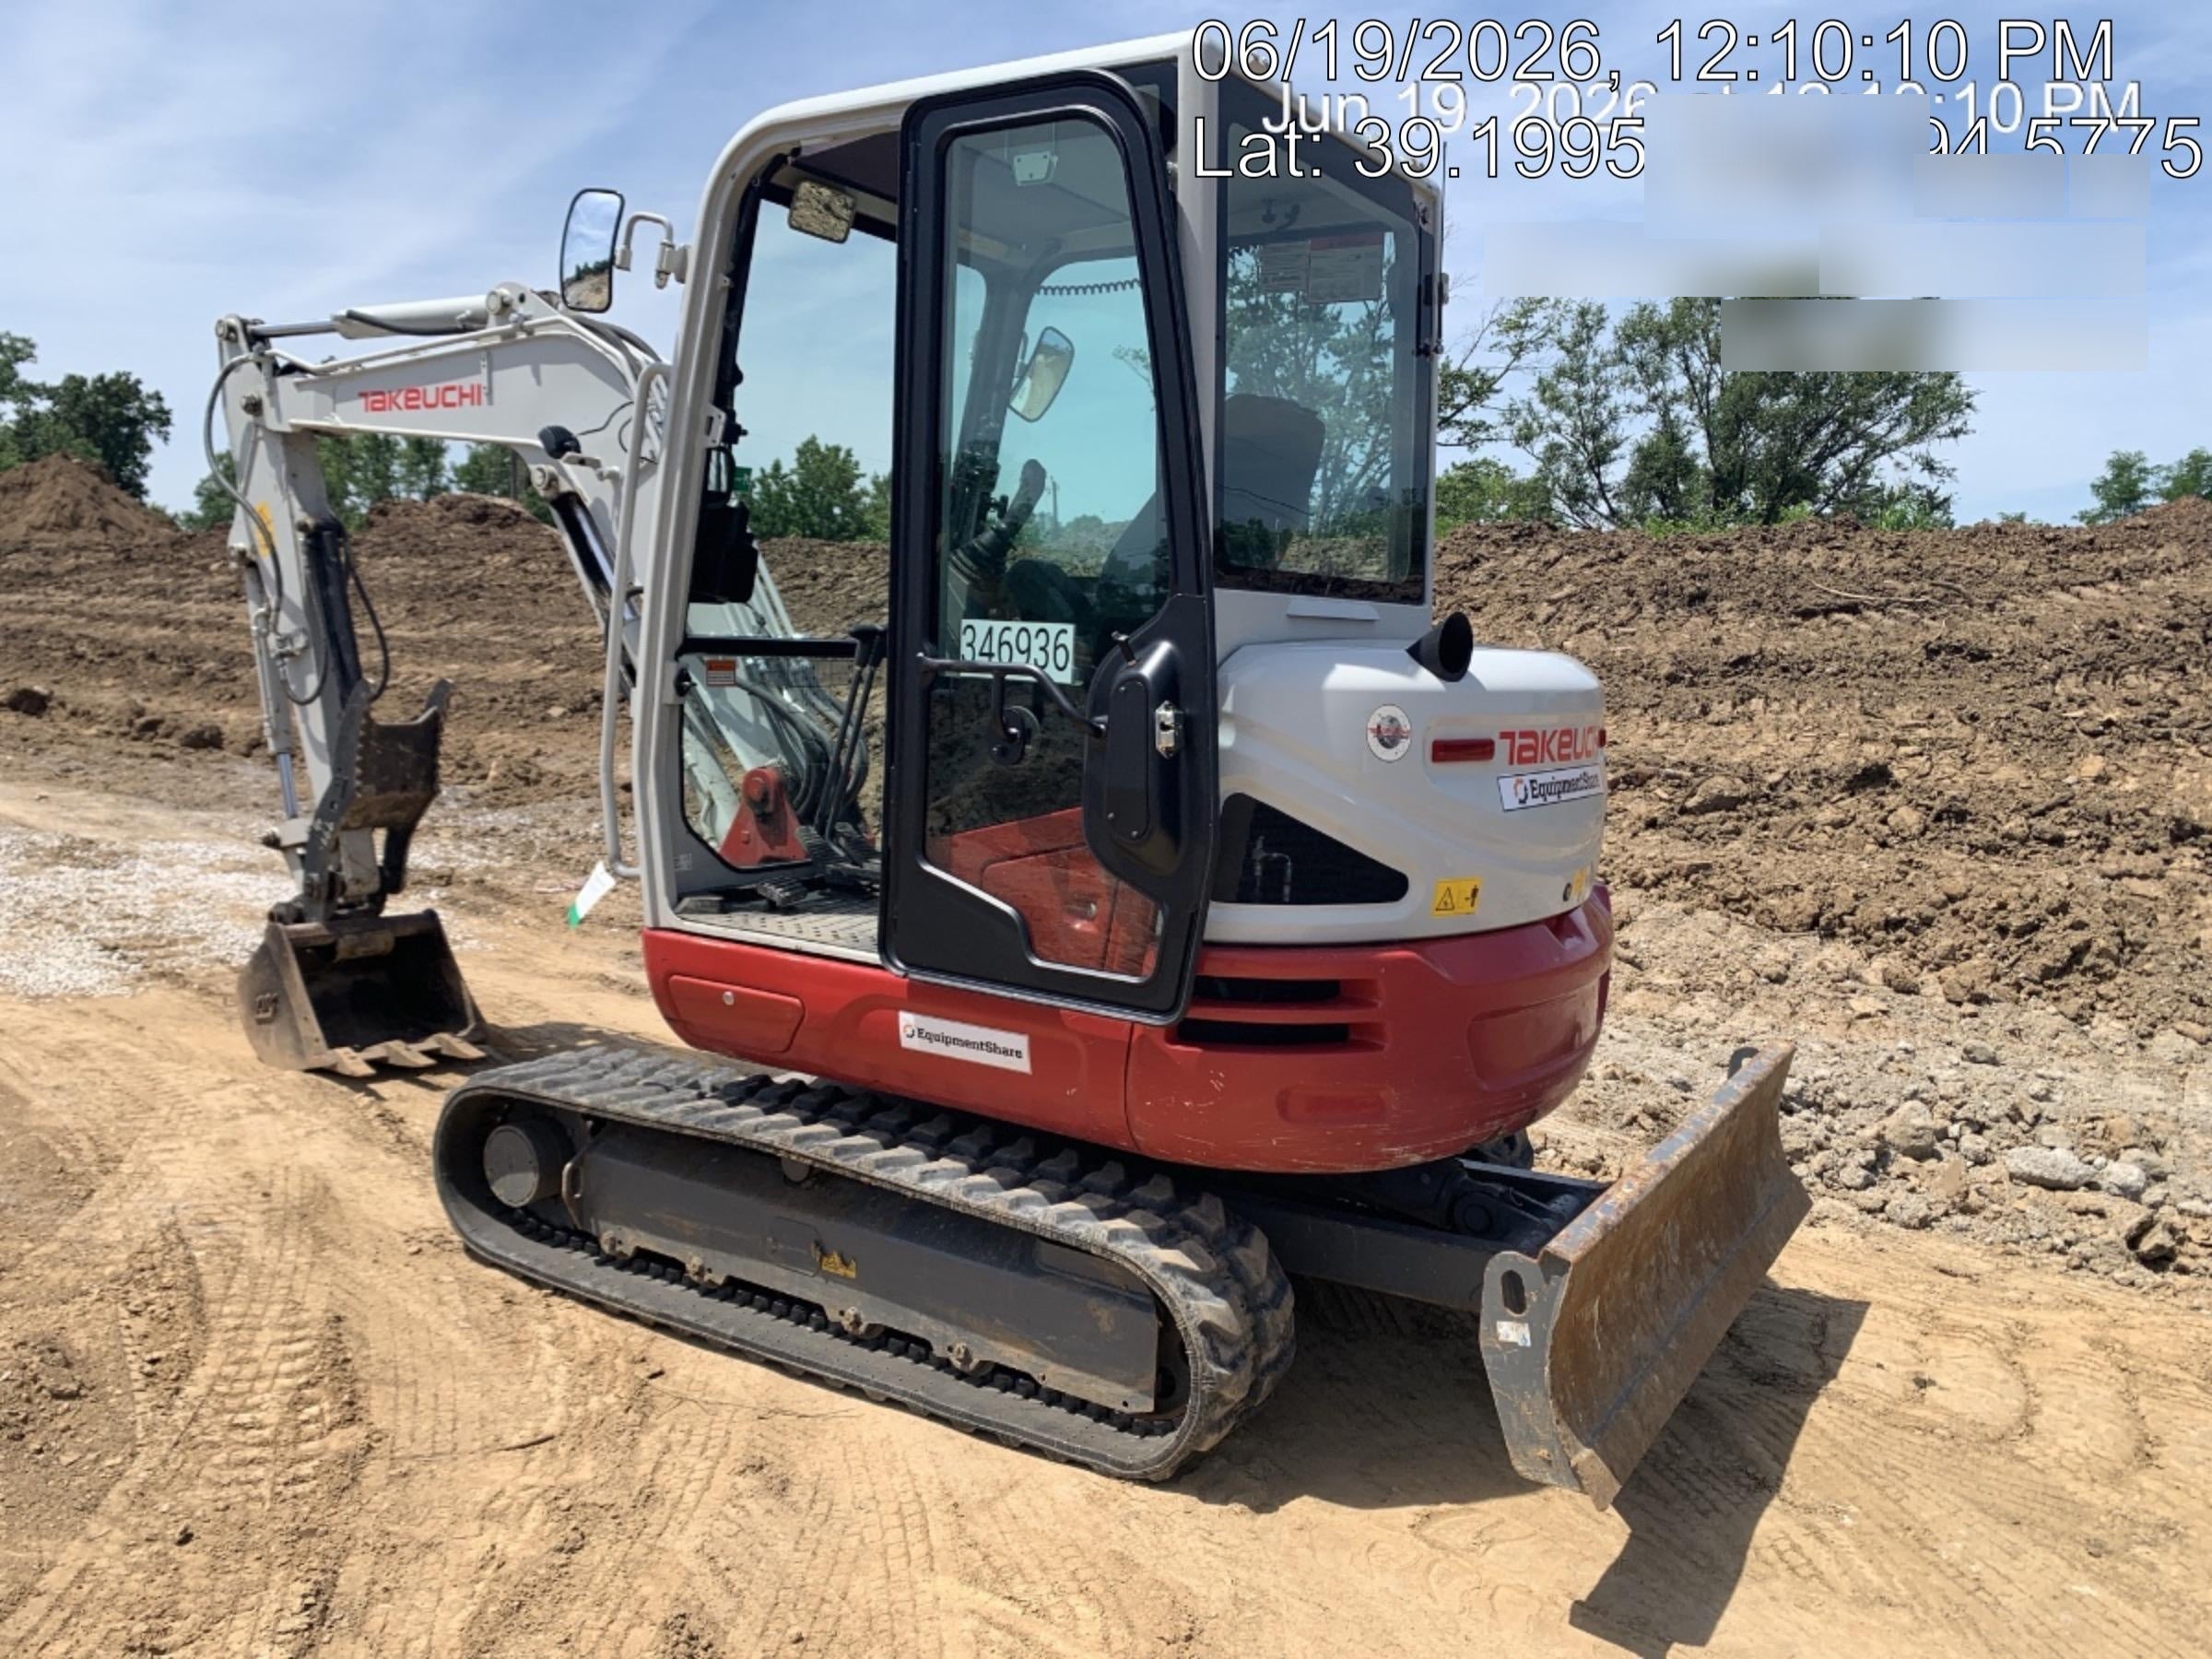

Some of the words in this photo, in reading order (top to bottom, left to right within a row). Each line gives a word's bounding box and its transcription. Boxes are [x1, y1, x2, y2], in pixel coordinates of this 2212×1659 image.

[358, 383, 482, 412] TAKEUCHI
[962, 624, 1069, 671] 346936
[1499, 725, 1599, 766] TAKEUC
[916, 1028, 1023, 1059] EquipmentShare
